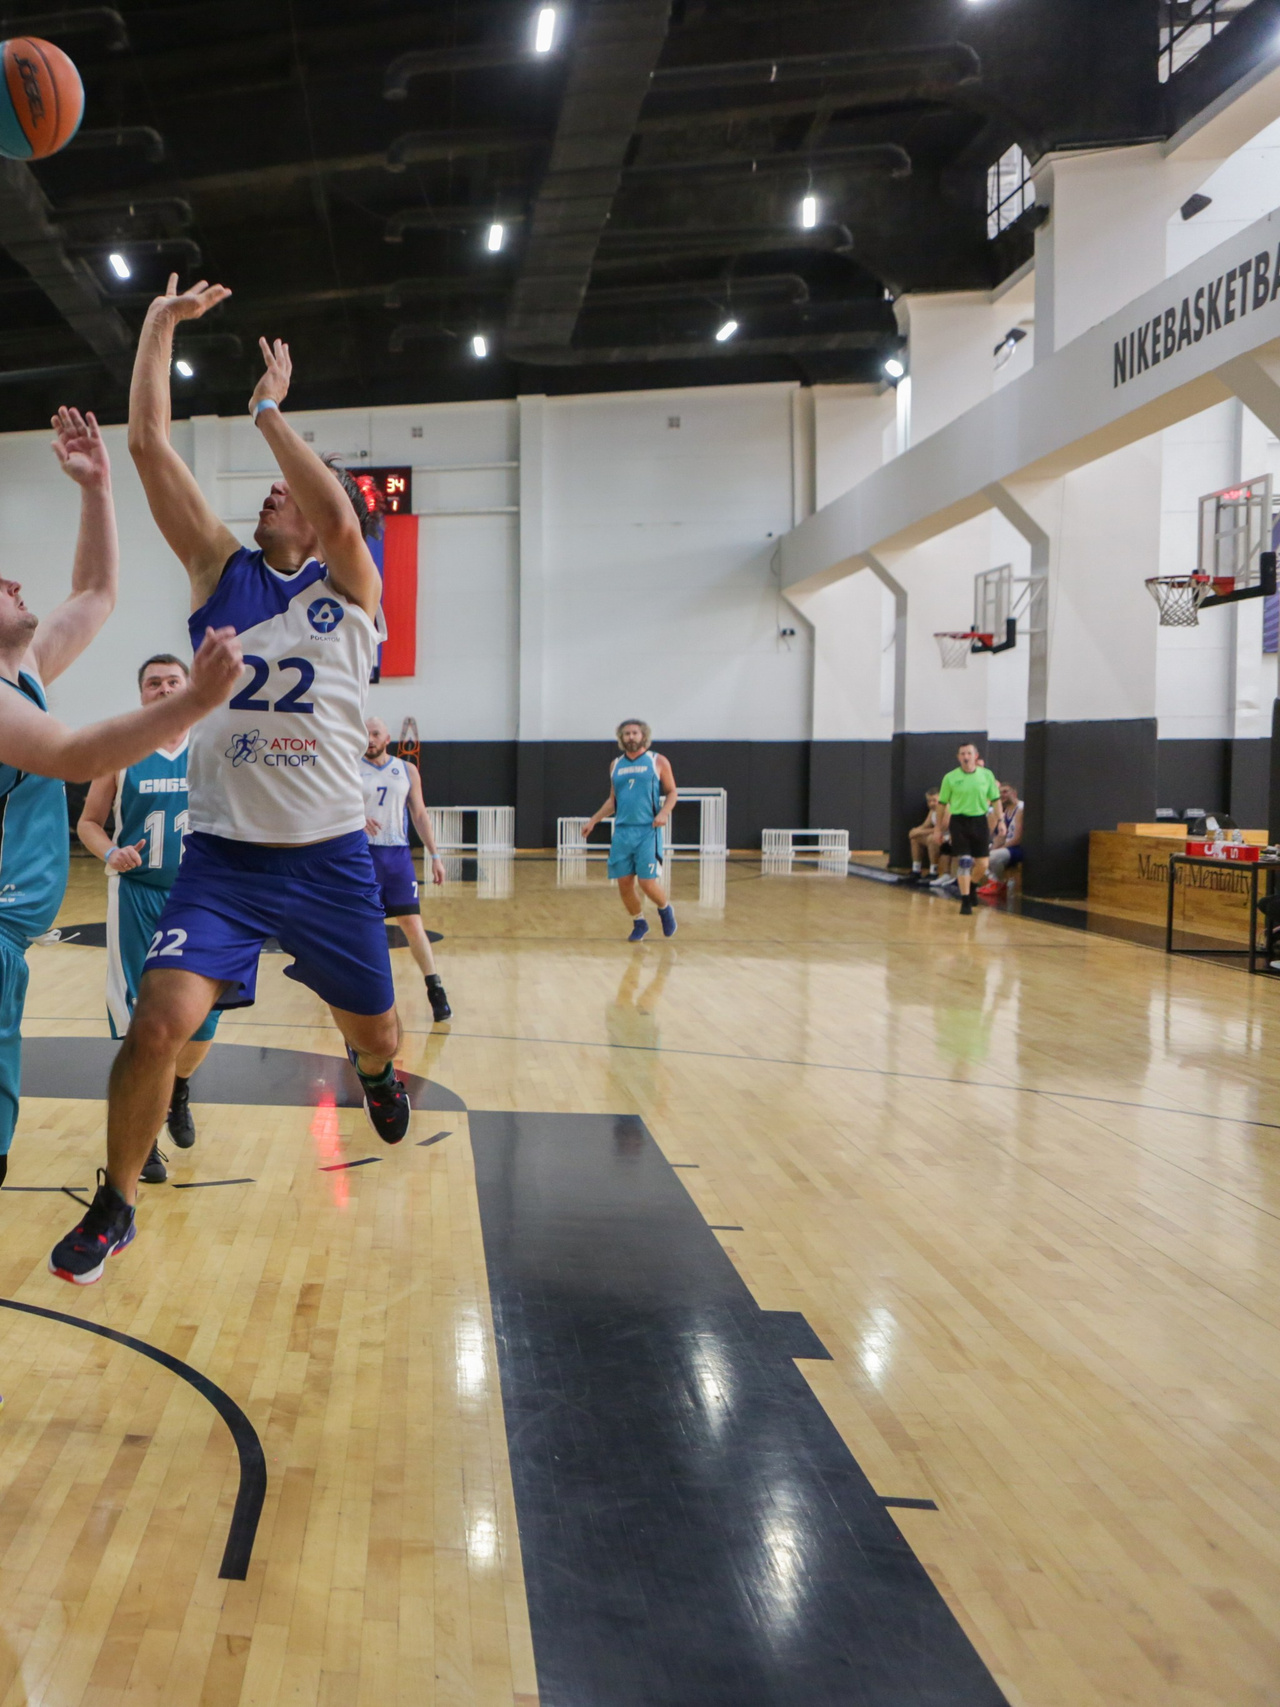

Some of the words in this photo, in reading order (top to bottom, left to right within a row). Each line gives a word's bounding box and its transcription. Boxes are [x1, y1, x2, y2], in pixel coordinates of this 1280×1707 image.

[386, 477, 405, 493] 34
[229, 654, 315, 714] 22
[270, 737, 317, 751] АТОМ
[263, 754, 319, 767] СПОРТ
[628, 778, 635, 790] 7
[376, 786, 388, 806] 7
[143, 809, 193, 869] 11
[648, 863, 655, 874] 7
[1138, 853, 1183, 885] Mama
[1185, 861, 1251, 907] Mentality
[411, 881, 419, 898] 7
[145, 928, 188, 961] 22
